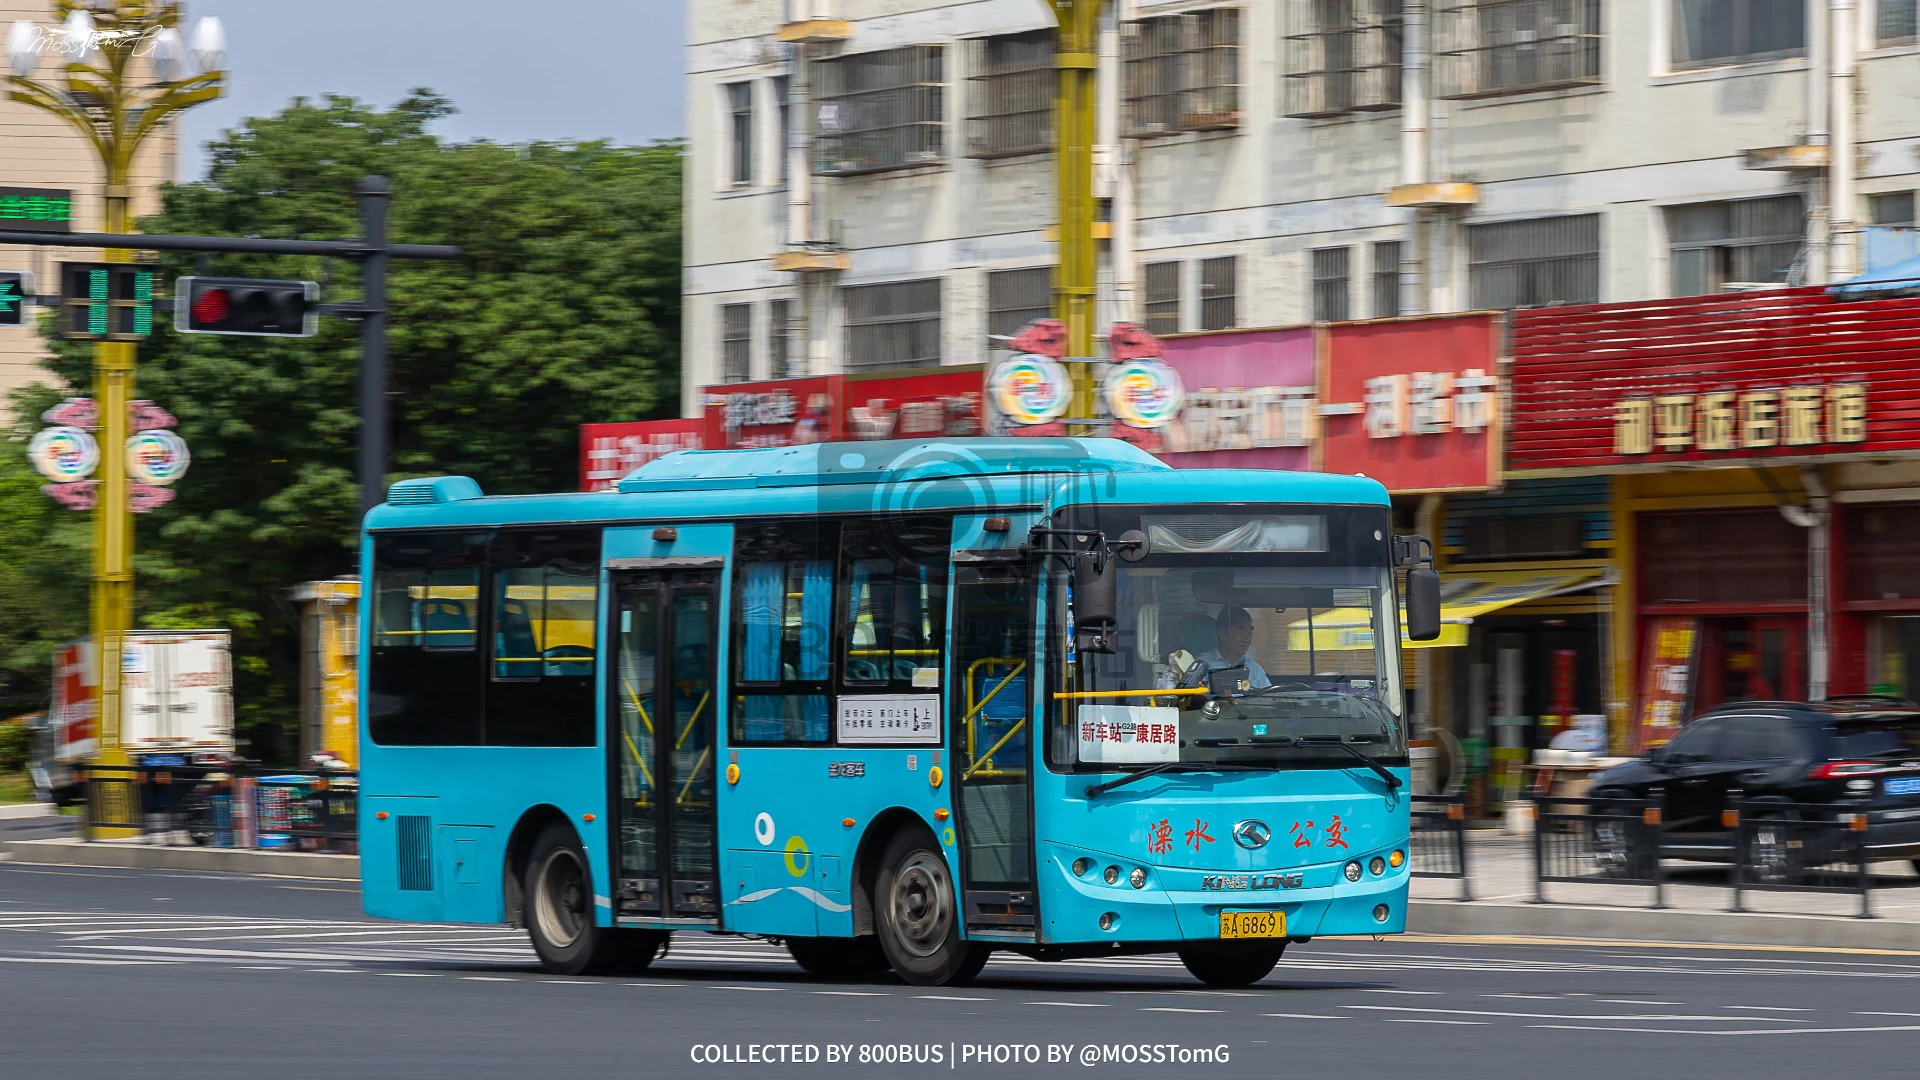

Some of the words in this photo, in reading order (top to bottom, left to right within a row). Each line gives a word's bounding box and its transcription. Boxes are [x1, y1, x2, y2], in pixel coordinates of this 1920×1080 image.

[1147, 818, 1216, 855] 溧水
[1289, 815, 1349, 850] 公交
[1201, 875, 1249, 891] KING
[1251, 872, 1304, 889] LONG
